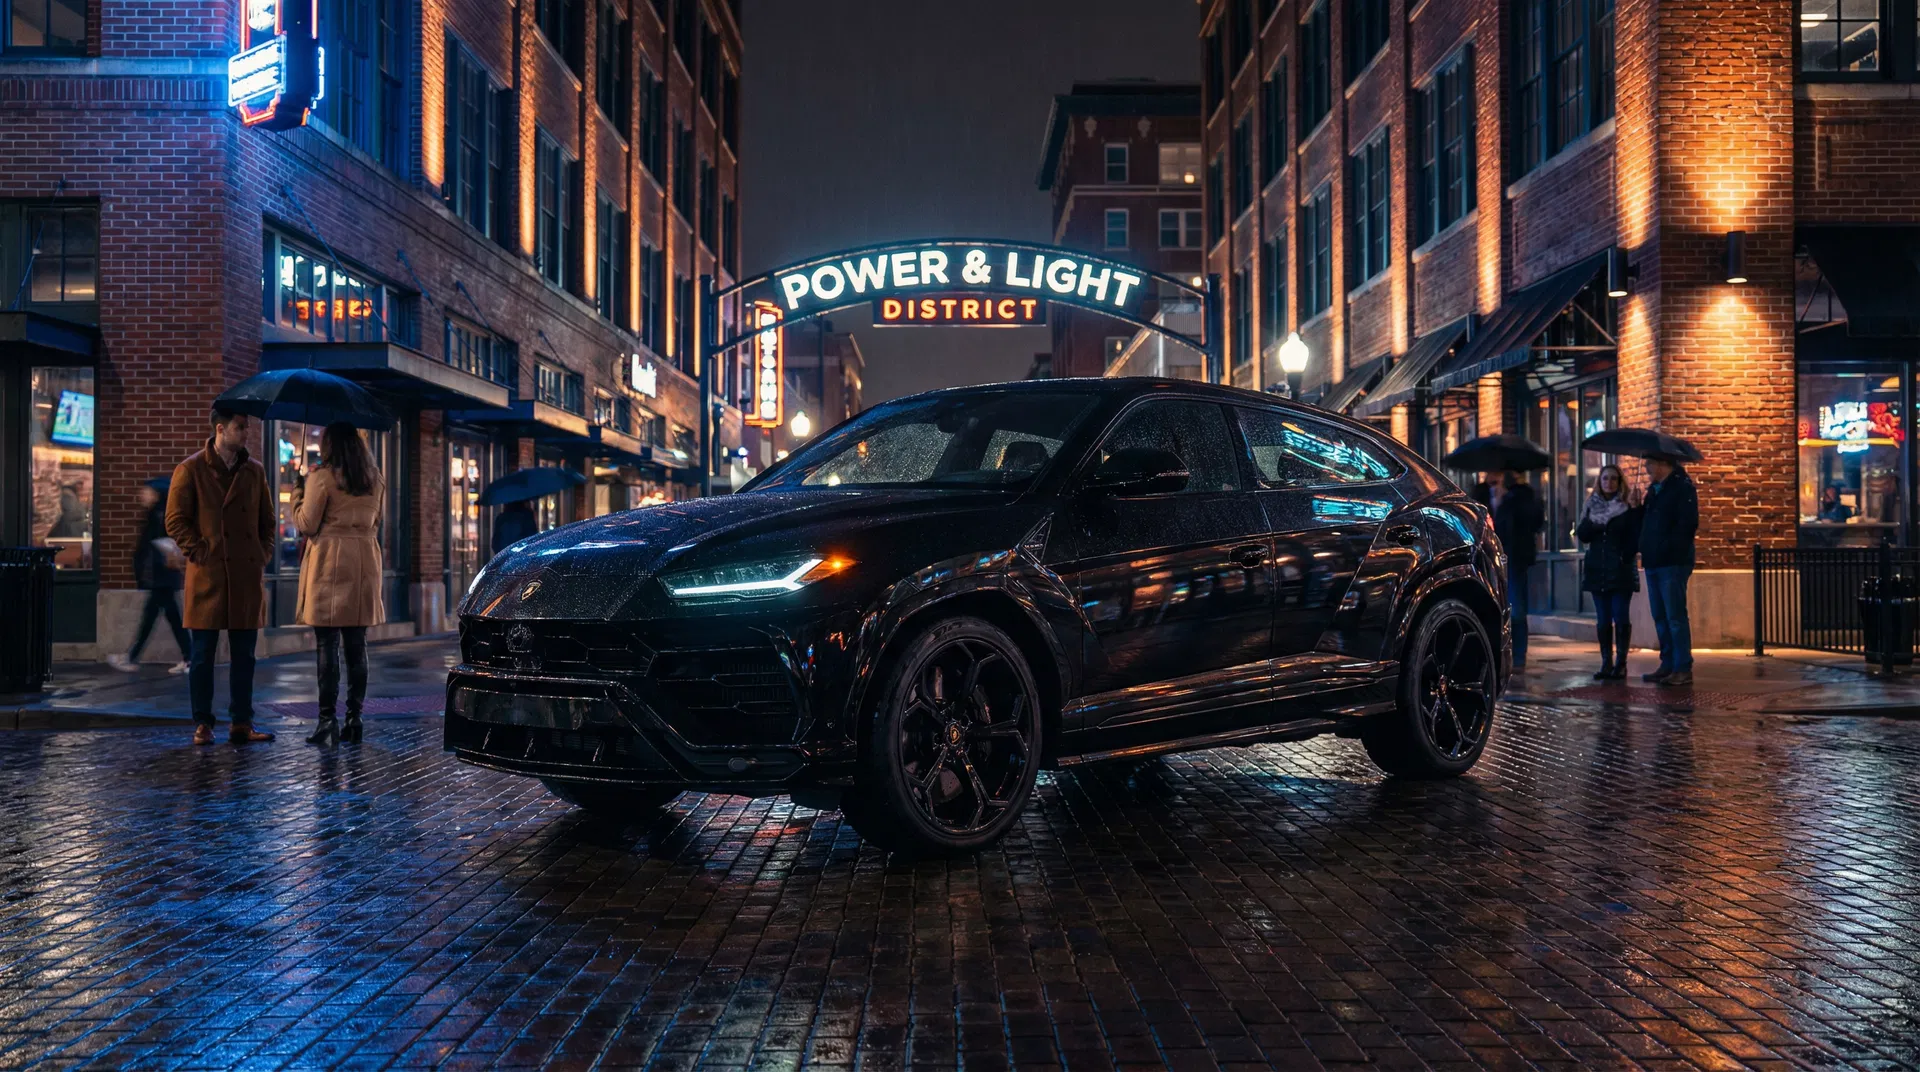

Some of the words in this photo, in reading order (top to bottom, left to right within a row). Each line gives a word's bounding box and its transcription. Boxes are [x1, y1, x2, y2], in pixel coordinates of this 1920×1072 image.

[781, 251, 950, 309] POWER
[962, 250, 992, 283] &
[1006, 252, 1141, 306] LIGHT
[883, 299, 1037, 319] DISTRICT
